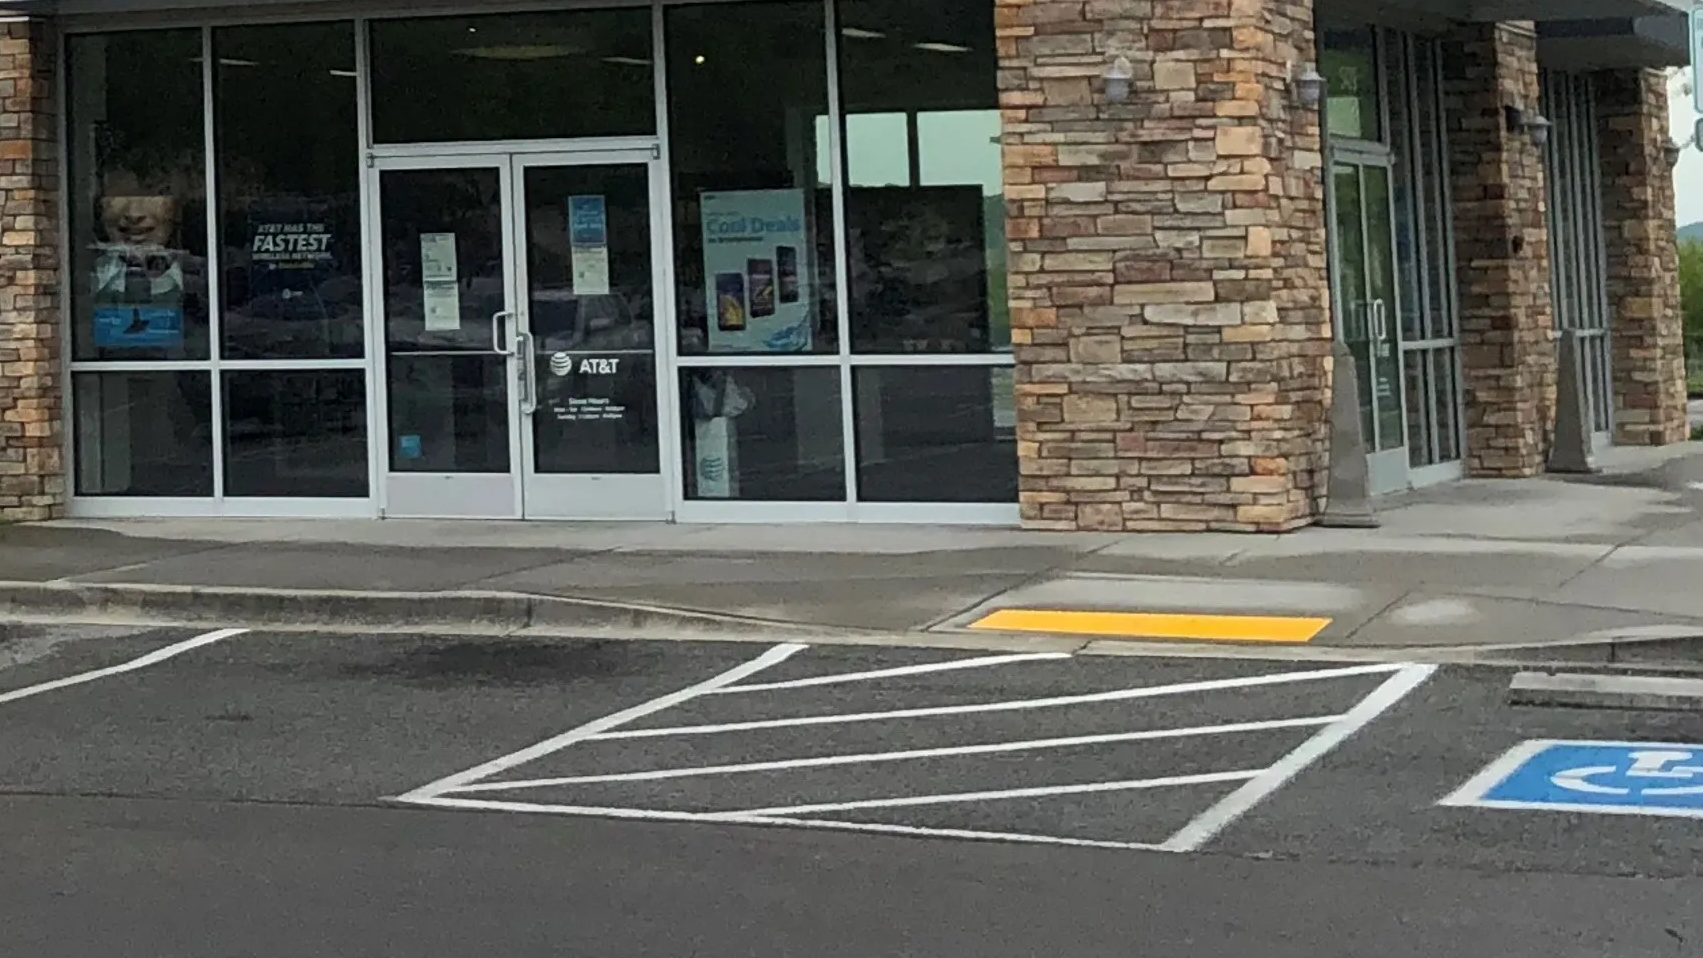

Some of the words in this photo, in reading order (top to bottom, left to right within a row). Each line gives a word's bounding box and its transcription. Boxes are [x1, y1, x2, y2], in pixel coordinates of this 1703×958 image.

[706, 216, 747, 234] Cool
[751, 214, 801, 233] Deals
[252, 233, 332, 252] FASTEST
[578, 358, 620, 374] AT&T
